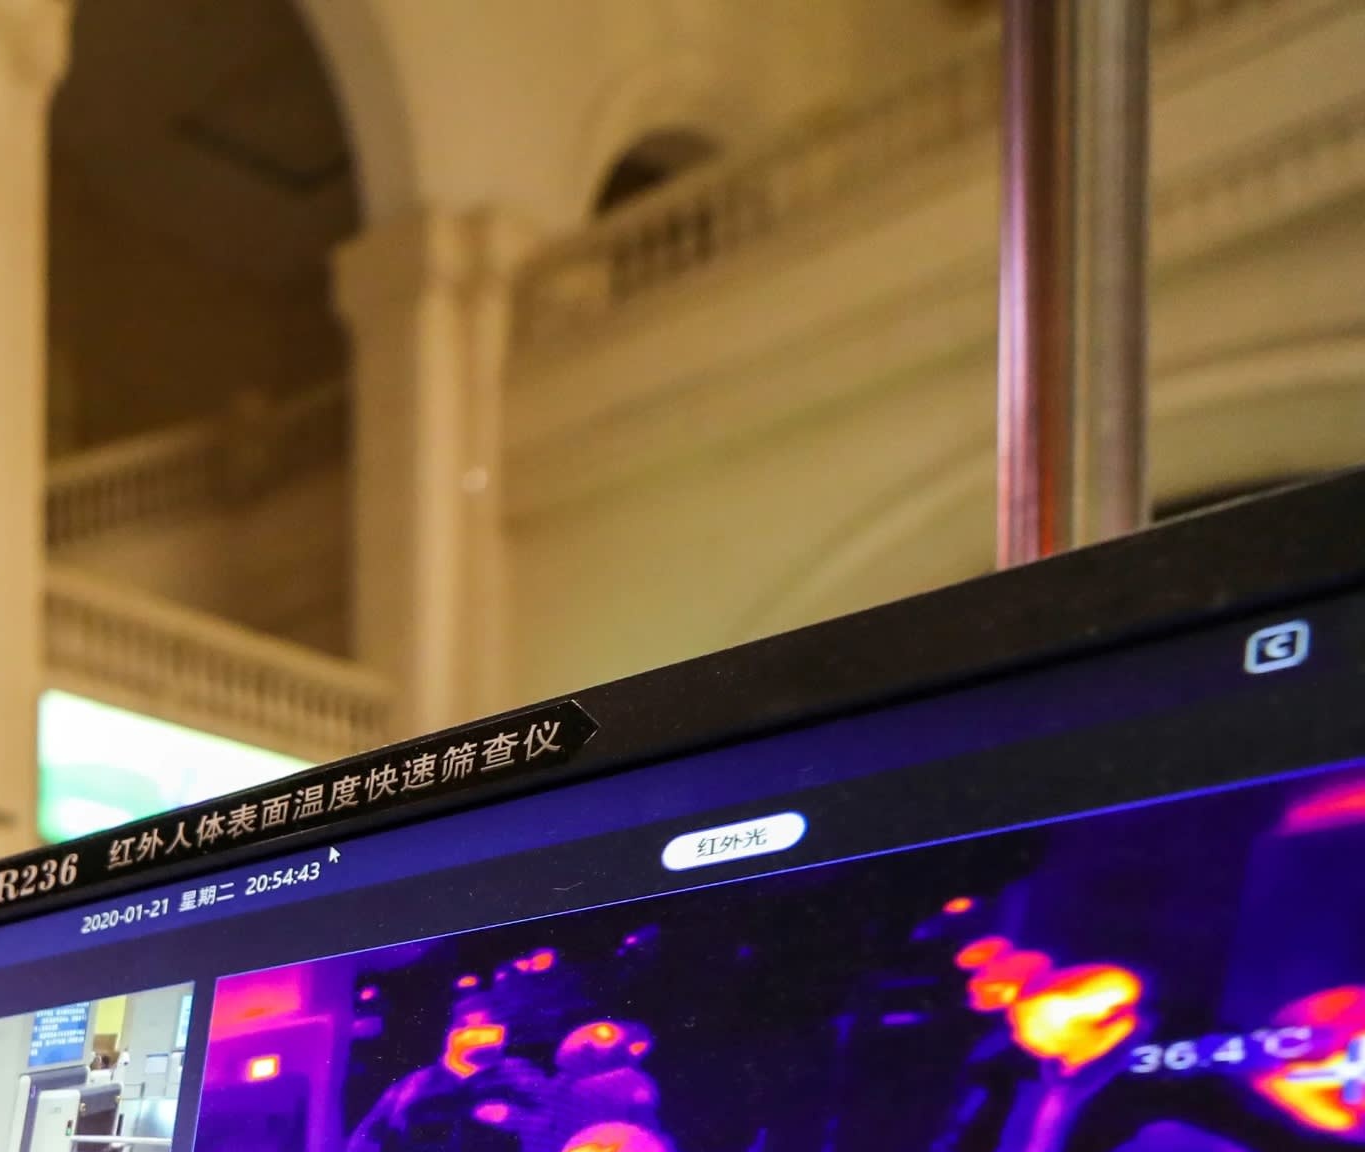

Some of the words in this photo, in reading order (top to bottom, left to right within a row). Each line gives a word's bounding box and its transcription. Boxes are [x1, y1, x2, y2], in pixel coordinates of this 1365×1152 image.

[107, 719, 563, 871] 红外人体表面温度快速筛查仪
[696, 827, 768, 858] 红外光
[80, 897, 170, 935] 2020-01-21
[177, 882, 236, 913] 星期二
[244, 860, 322, 898] 20:54:43
